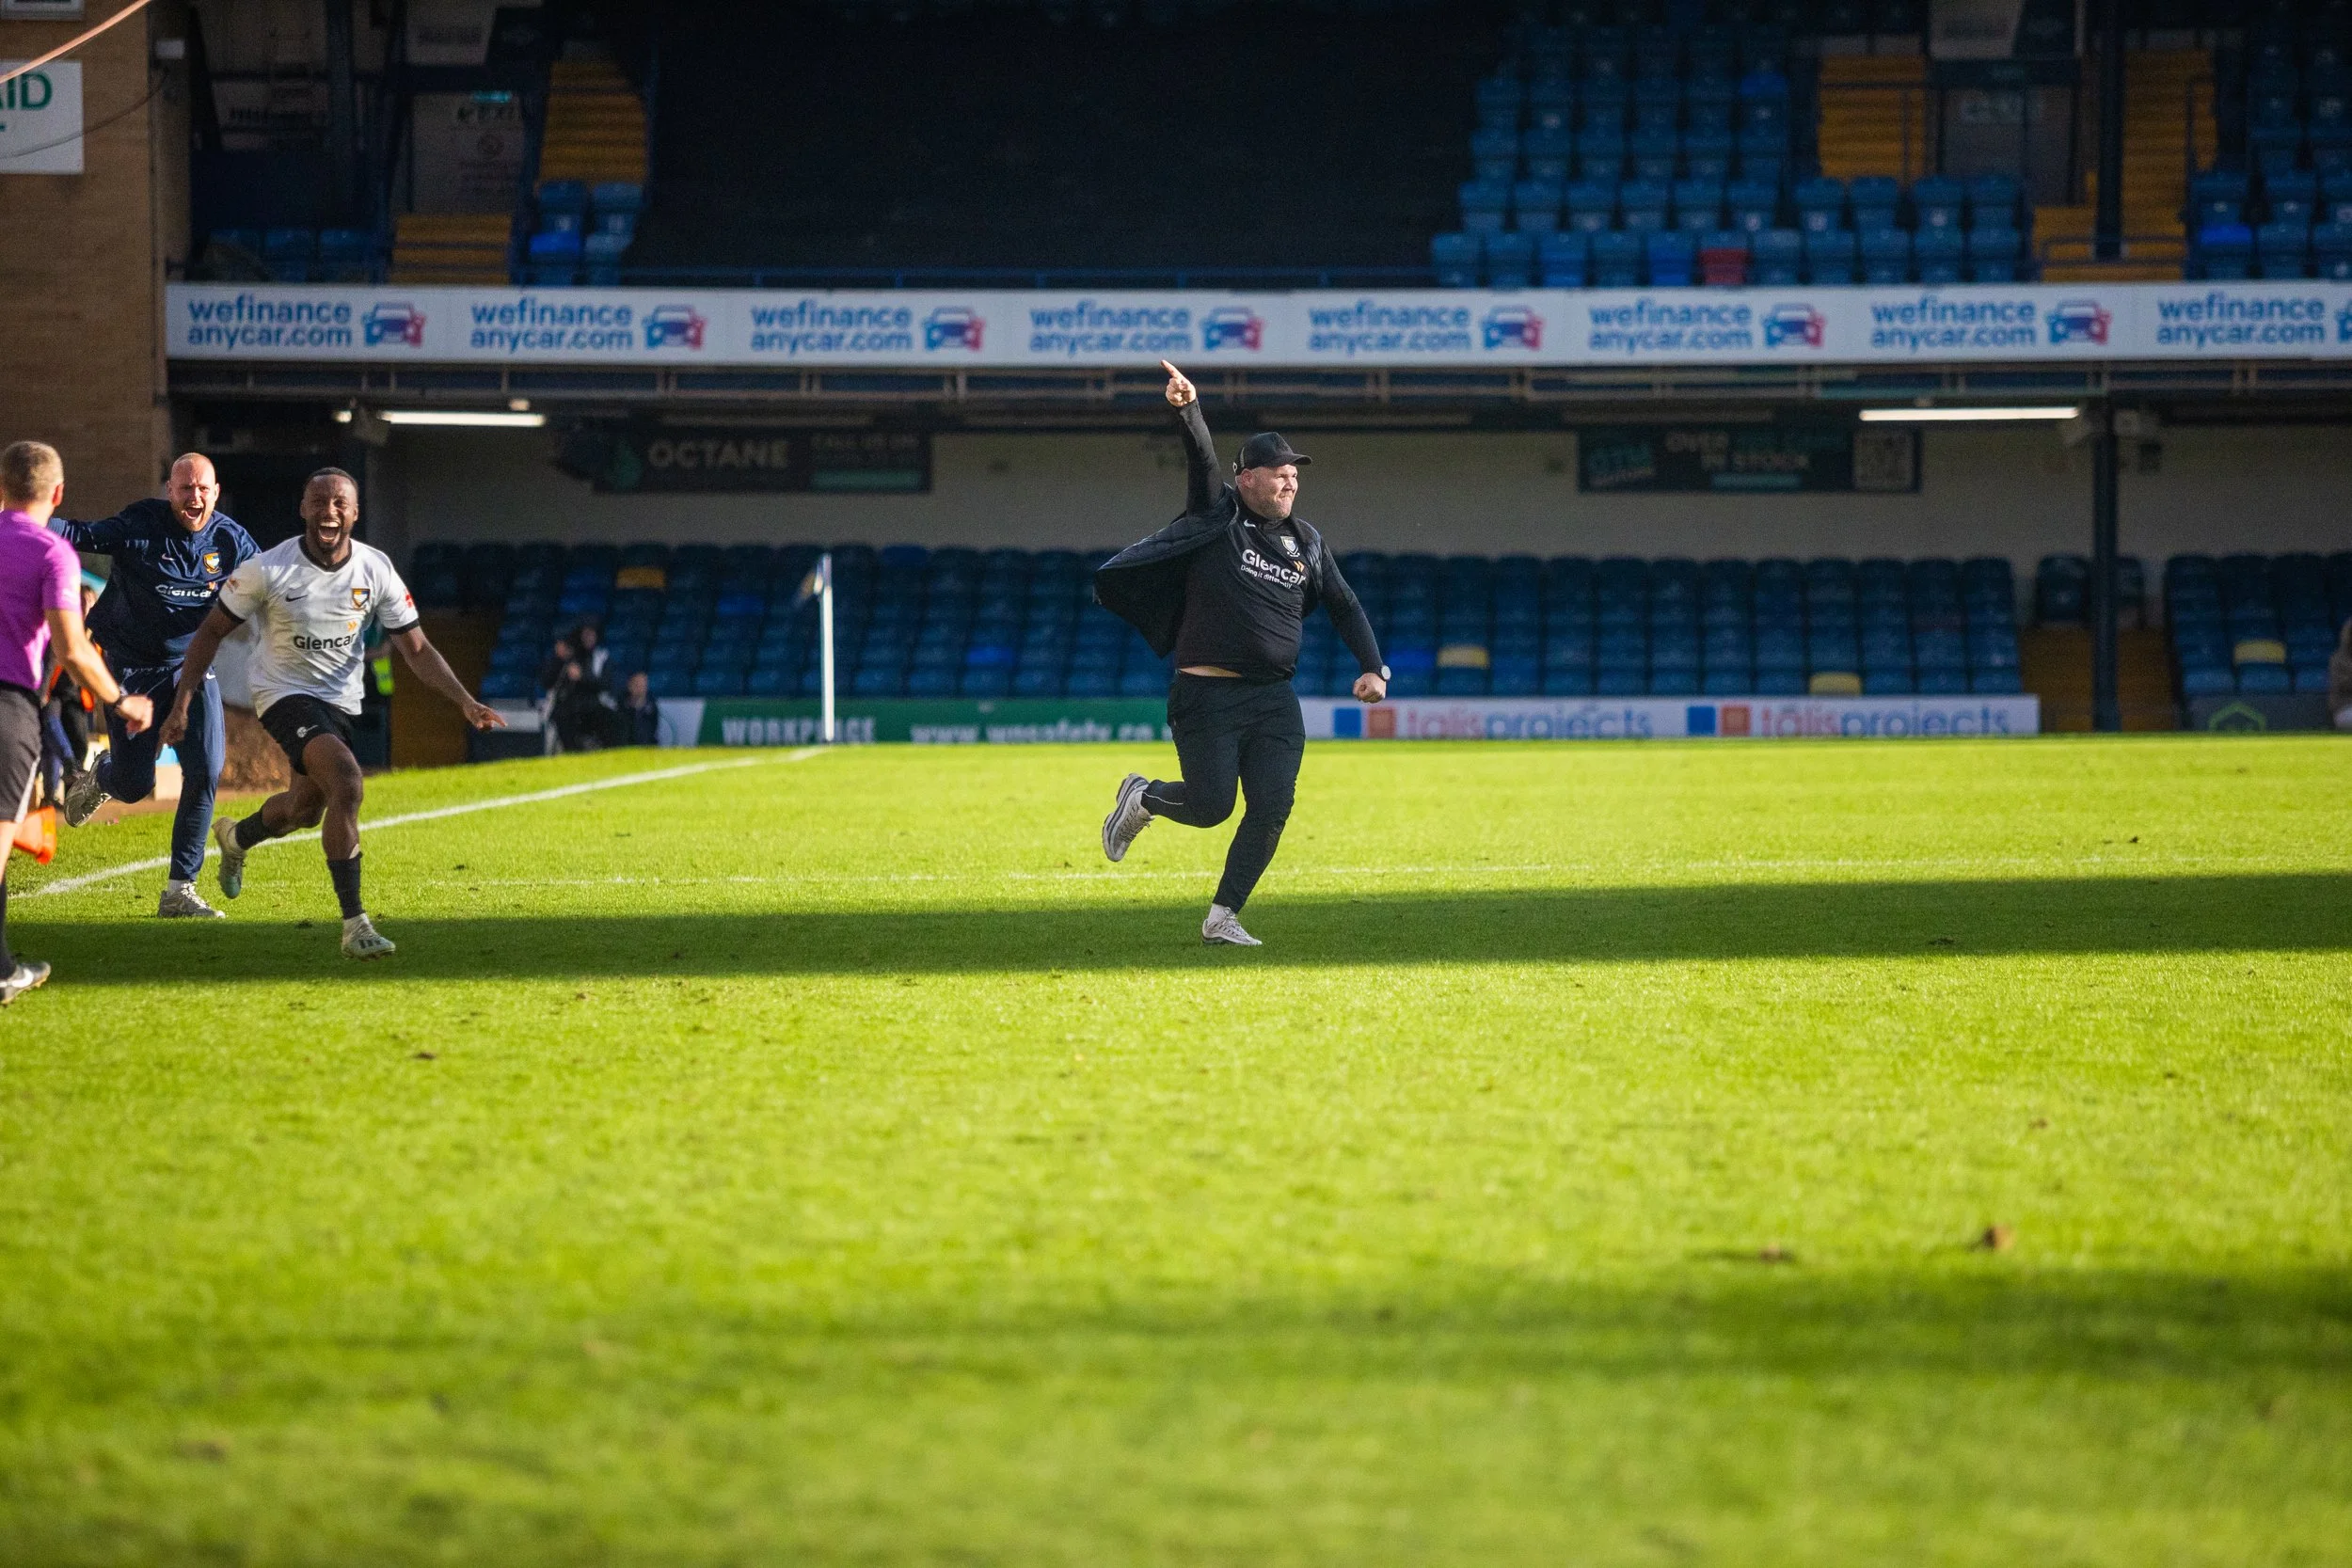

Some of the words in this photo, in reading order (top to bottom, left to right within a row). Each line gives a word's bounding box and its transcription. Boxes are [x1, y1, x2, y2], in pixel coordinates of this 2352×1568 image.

[0, 73, 53, 110] ID
[187, 293, 351, 324] wefinance
[471, 297, 632, 326] wefinance
[751, 301, 912, 328] wefinance
[1029, 302, 1191, 328] wefinance
[1309, 302, 1470, 328] wefinance
[1589, 299, 1752, 326] wefinance
[1872, 296, 2036, 324] wefinance
[2158, 293, 2326, 321] wefinance
[187, 325, 352, 350] anycar.com
[470, 328, 633, 353] anycar.com
[751, 331, 912, 354] anycar.com
[1030, 331, 1191, 354] anycar.com
[1310, 330, 1470, 354] anycar.com
[1590, 328, 1753, 352] anycar.com
[1872, 325, 2037, 350] anycar.com
[2157, 323, 2326, 347] anycar.com
[648, 438, 788, 468] OCTANE
[1240, 564, 1258, 578] Doing
[1263, 573, 1293, 589] differtly
[1242, 548, 1307, 585] Glencar
[155, 584, 212, 598] Glenca
[293, 633, 357, 651] Glencar
